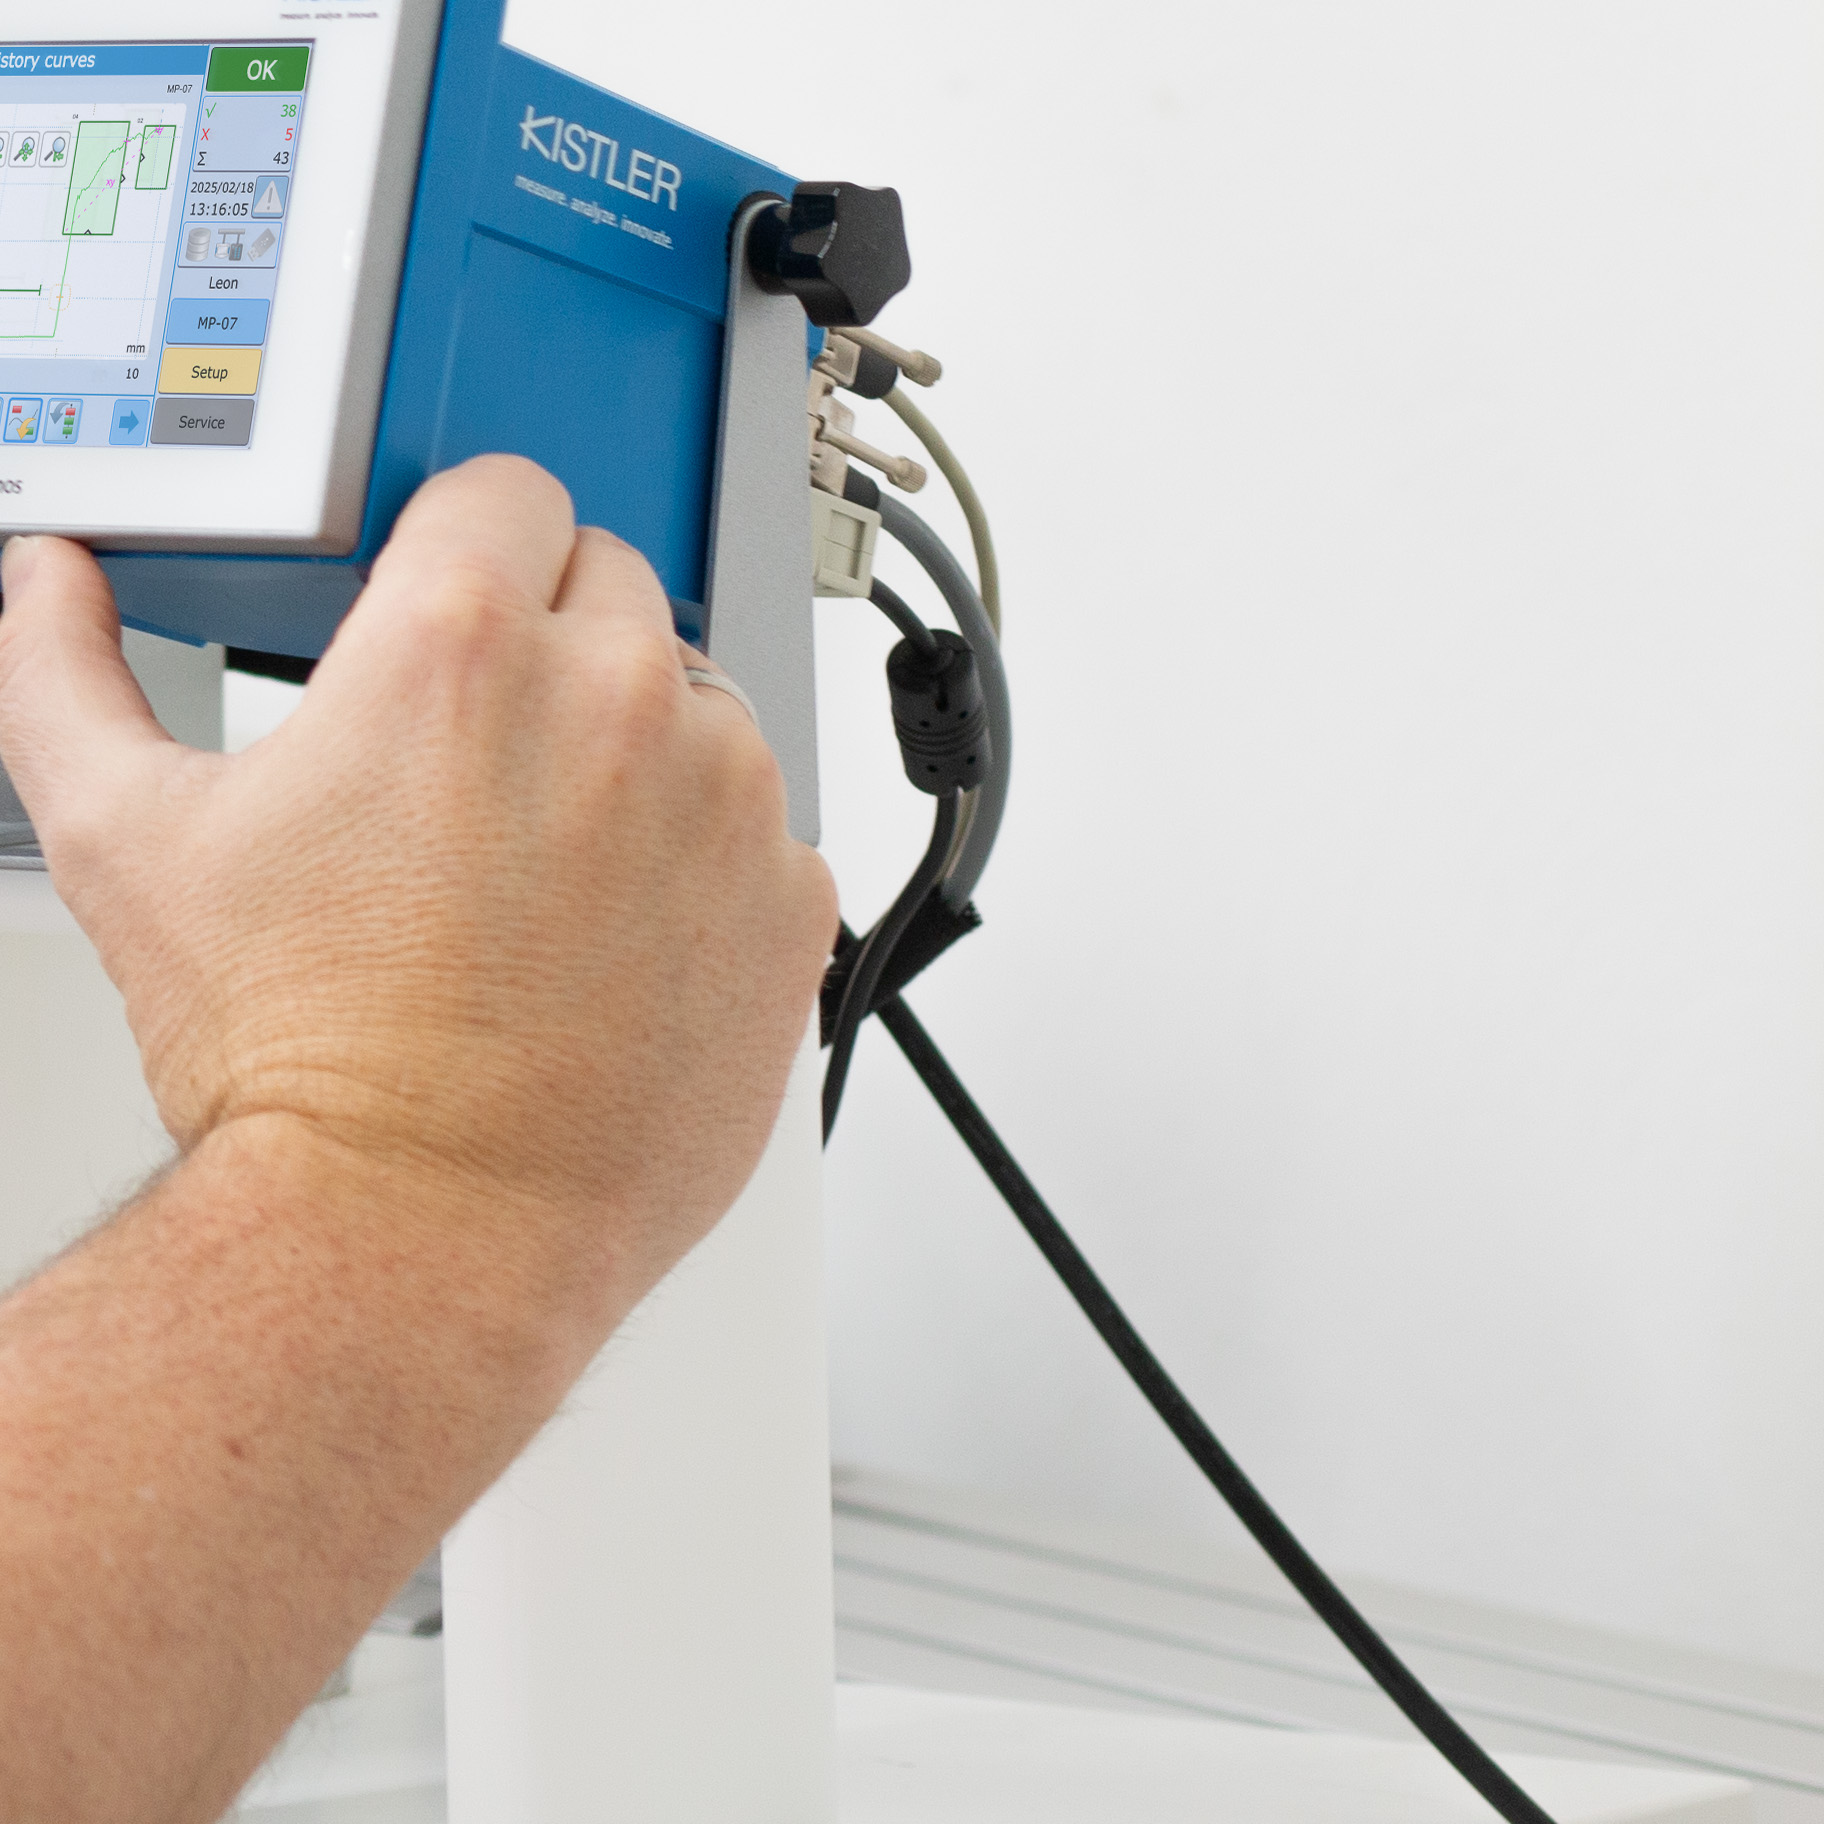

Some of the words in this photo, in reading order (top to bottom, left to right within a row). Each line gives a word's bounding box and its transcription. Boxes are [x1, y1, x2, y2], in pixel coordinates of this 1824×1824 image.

[44, 54, 95, 68] curves
[246, 59, 278, 81] OK
[167, 85, 193, 93] MP-07
[280, 104, 297, 117] 38
[285, 128, 293, 141] 5
[273, 151, 290, 165] 43
[519, 104, 682, 211] KISTLER
[191, 182, 254, 194] 2025/02/18
[190, 203, 249, 216] 13:16:05
[209, 276, 239, 289] Leon
[197, 317, 238, 330] MP-07
[126, 344, 145, 354] mm
[126, 368, 139, 380] 10
[191, 365, 228, 382] Setup
[179, 415, 225, 429] Service
